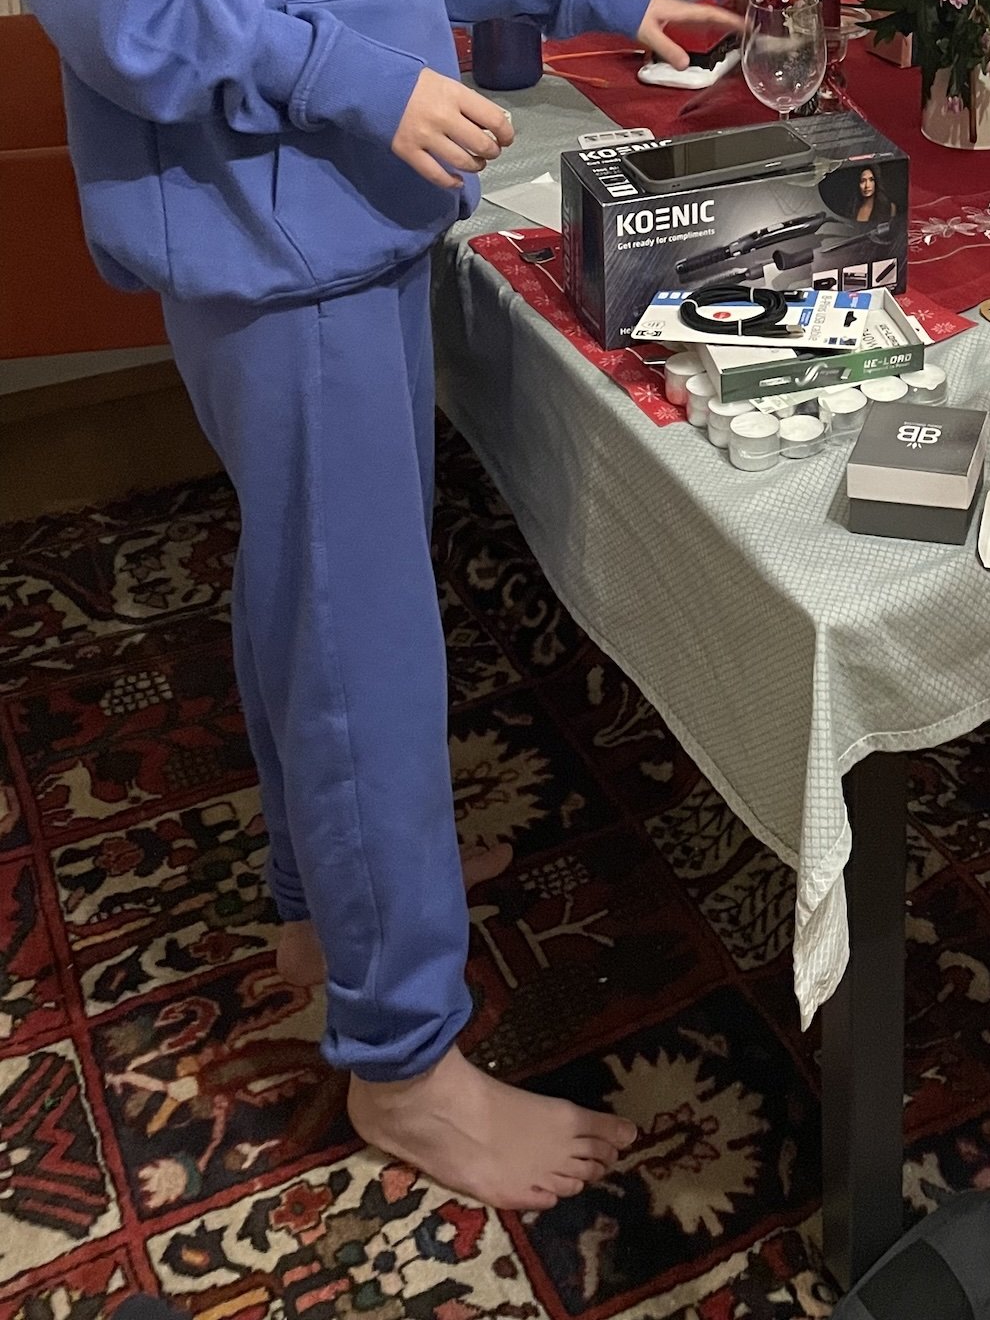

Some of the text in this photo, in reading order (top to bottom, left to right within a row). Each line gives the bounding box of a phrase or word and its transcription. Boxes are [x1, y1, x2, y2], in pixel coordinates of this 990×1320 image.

[616, 199, 715, 237] KOENIC
[617, 228, 716, 251] Get ready for compliments
